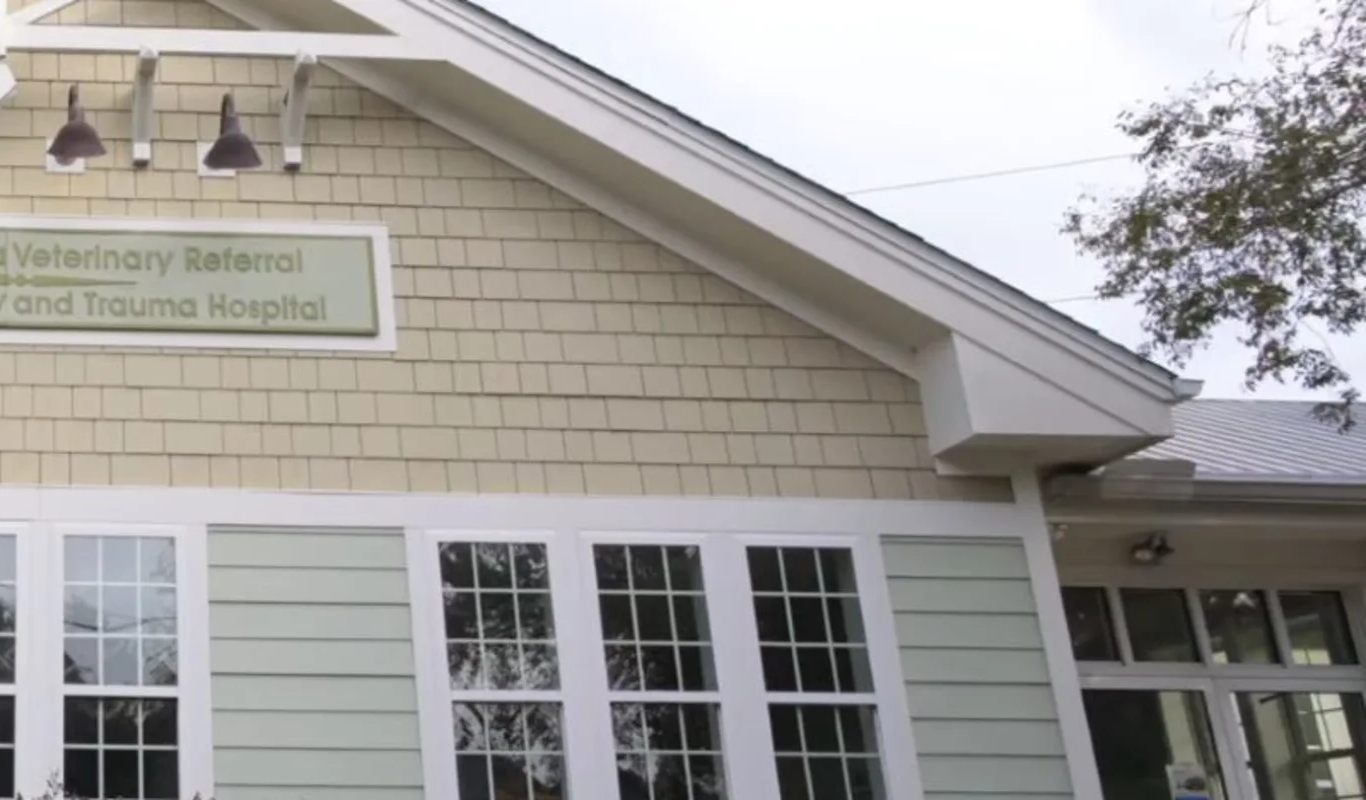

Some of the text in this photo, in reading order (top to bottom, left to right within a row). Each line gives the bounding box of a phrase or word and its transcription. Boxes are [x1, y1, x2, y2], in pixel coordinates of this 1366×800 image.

[12, 242, 174, 277] Veterinary
[185, 246, 304, 274] Referral
[12, 290, 74, 316] and
[83, 291, 198, 319] Trauma
[208, 293, 327, 326] Hospital
